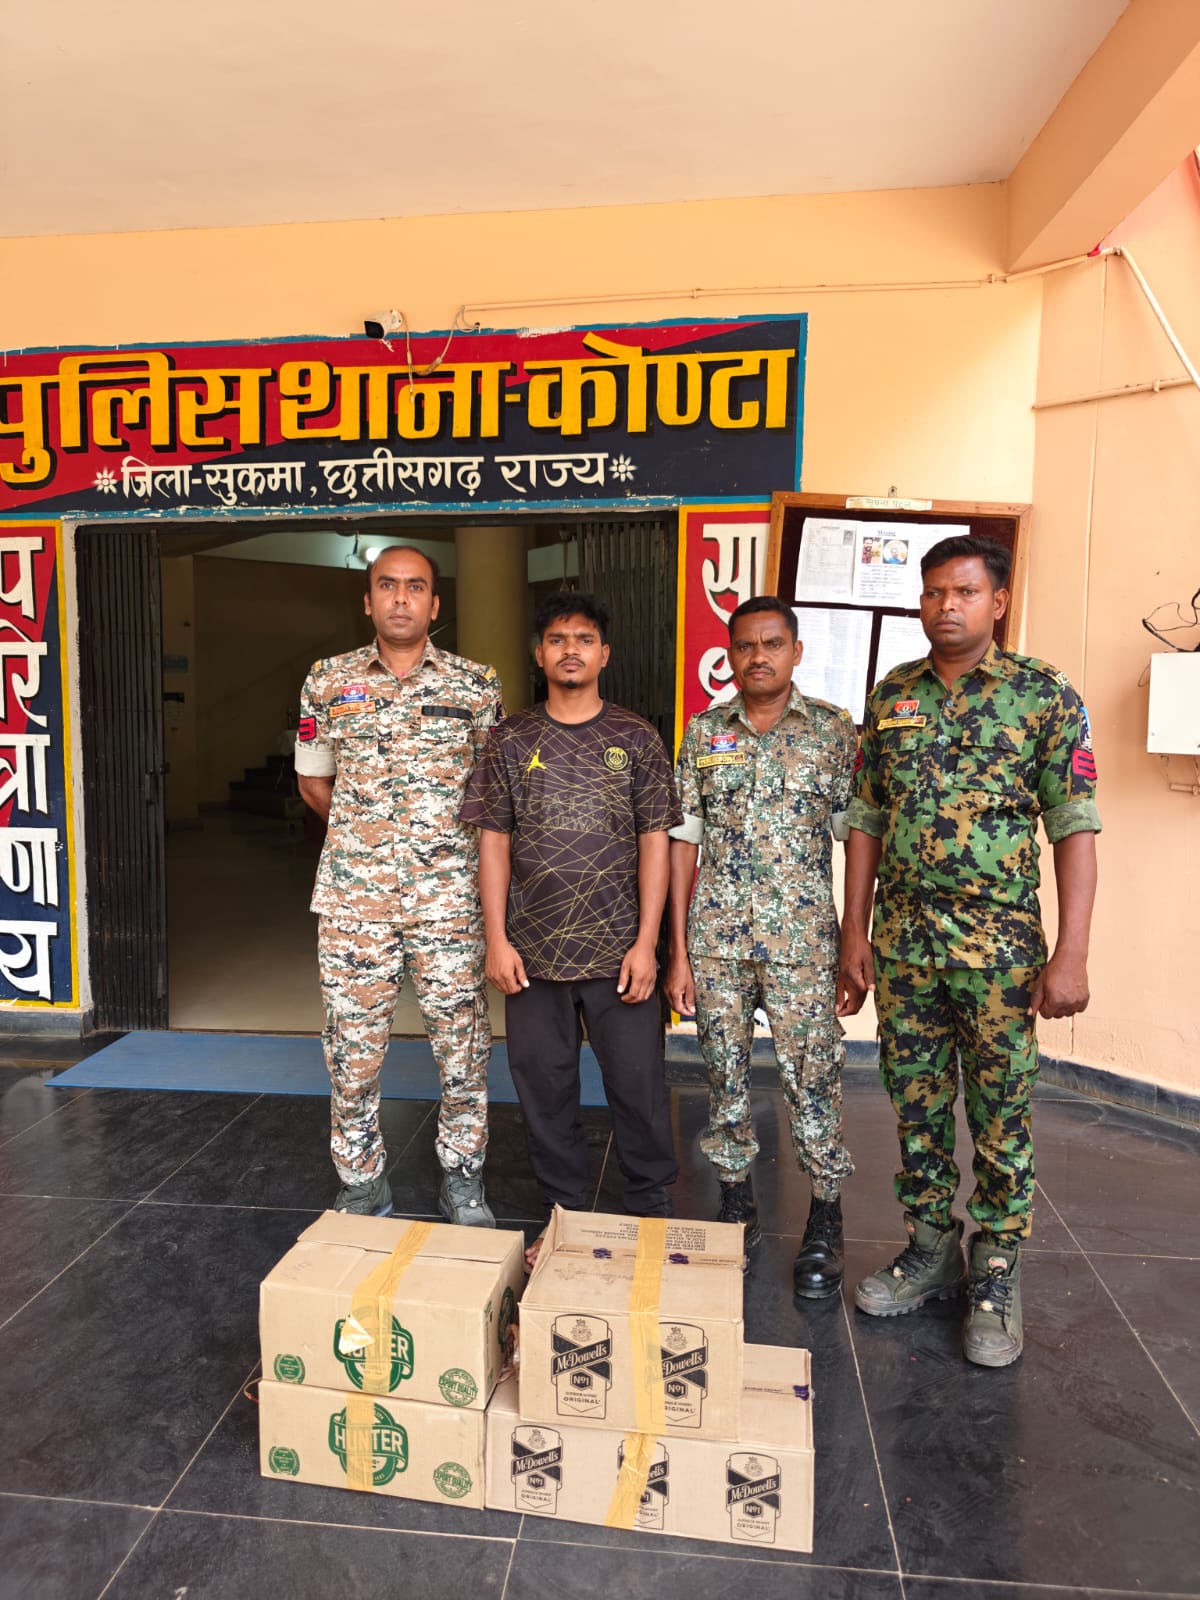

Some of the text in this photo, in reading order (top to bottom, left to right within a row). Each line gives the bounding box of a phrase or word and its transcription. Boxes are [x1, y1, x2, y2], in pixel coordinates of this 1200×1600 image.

[0, 352, 272, 483] पुलिस
[319, 447, 484, 499] छत्तीसगढ़
[494, 453, 609, 493] राज्य
[556, 1343, 607, 1373] McDowell's
[662, 1351, 703, 1376] cDowell's
[563, 1397, 599, 1405] ORIGINAL
[664, 1405, 694, 1413] RIGINAL
[335, 1424, 404, 1456] HUNTER
[731, 1479, 777, 1503] McDowell's
